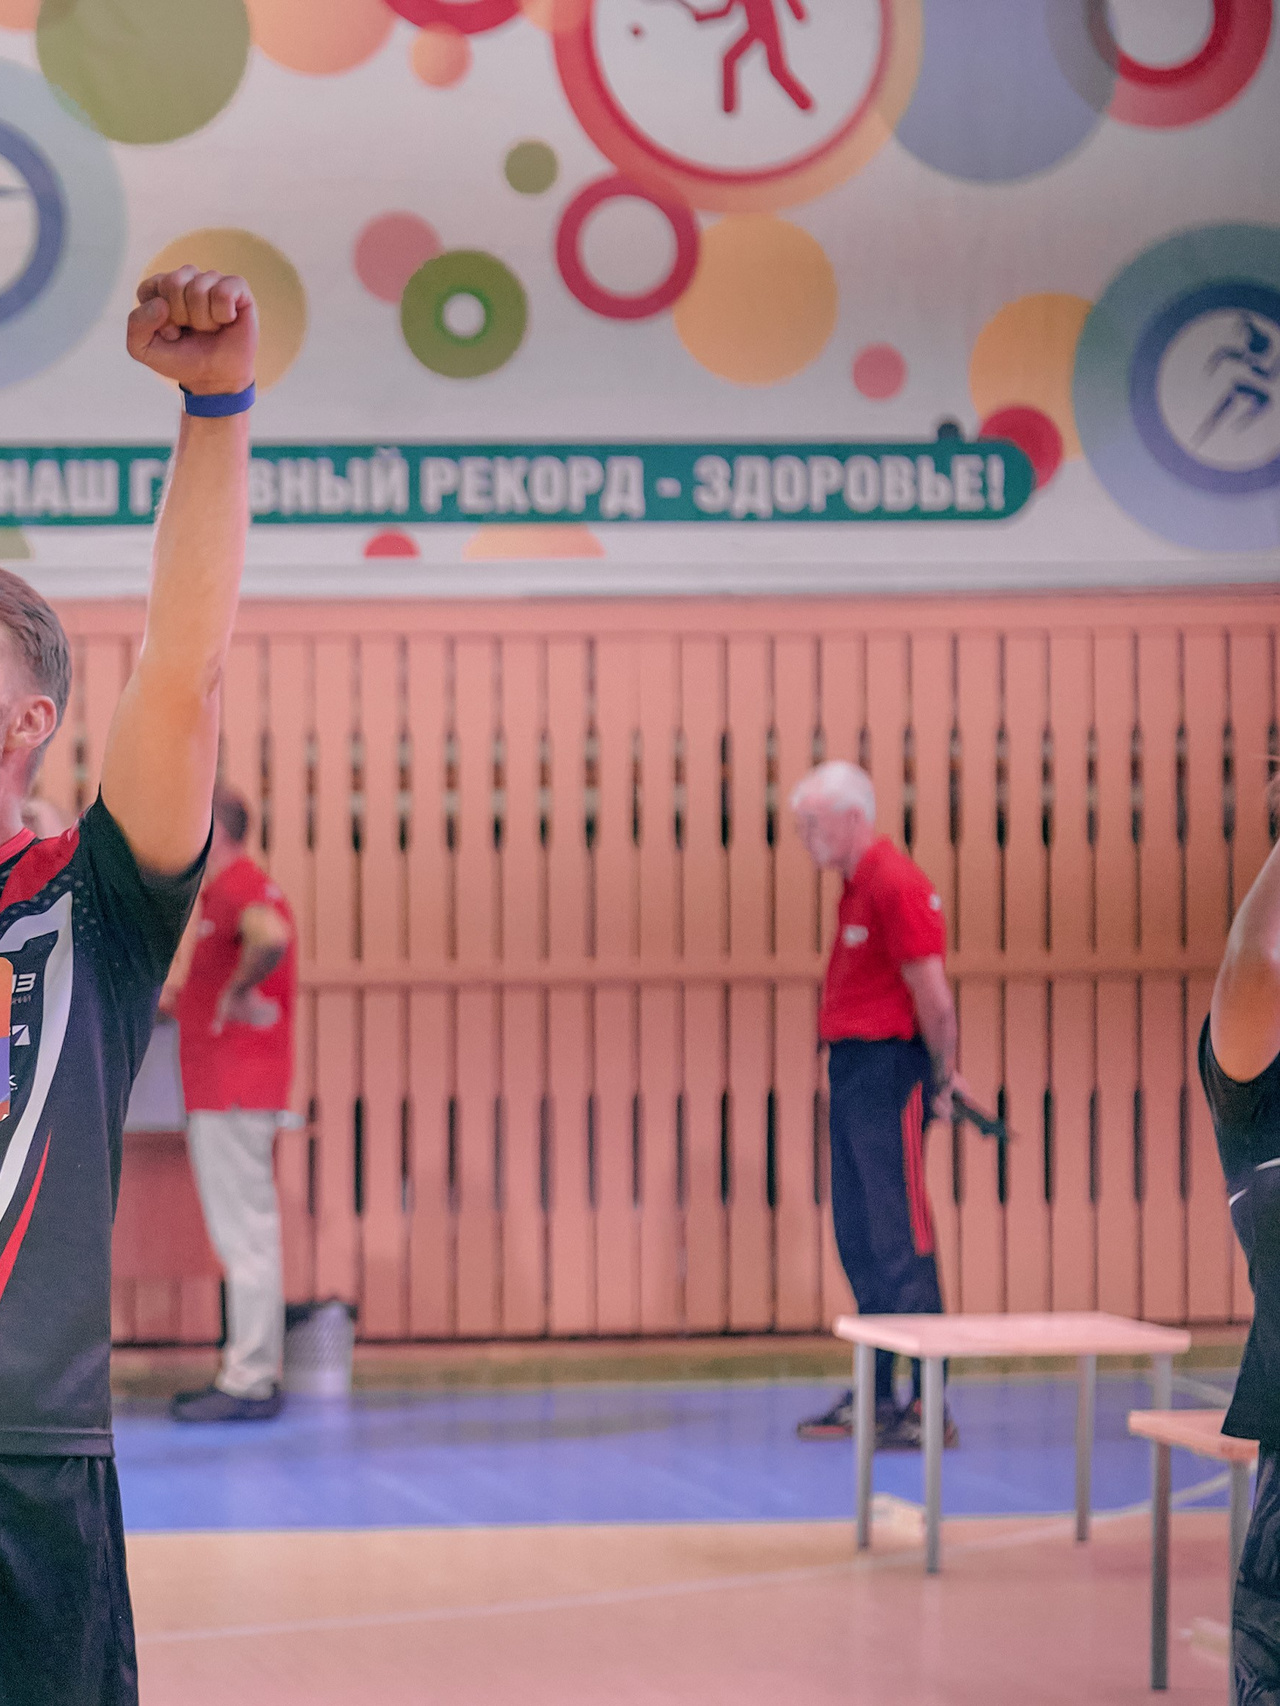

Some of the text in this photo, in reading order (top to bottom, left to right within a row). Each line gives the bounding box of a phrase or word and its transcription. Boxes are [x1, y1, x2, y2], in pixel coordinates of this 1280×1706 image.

[129, 447, 409, 516] ГВНЫЙ
[422, 455, 646, 519] РЕКОРД
[655, 477, 682, 499] -
[692, 454, 1006, 519] ЗДОРОВЬЕ!
